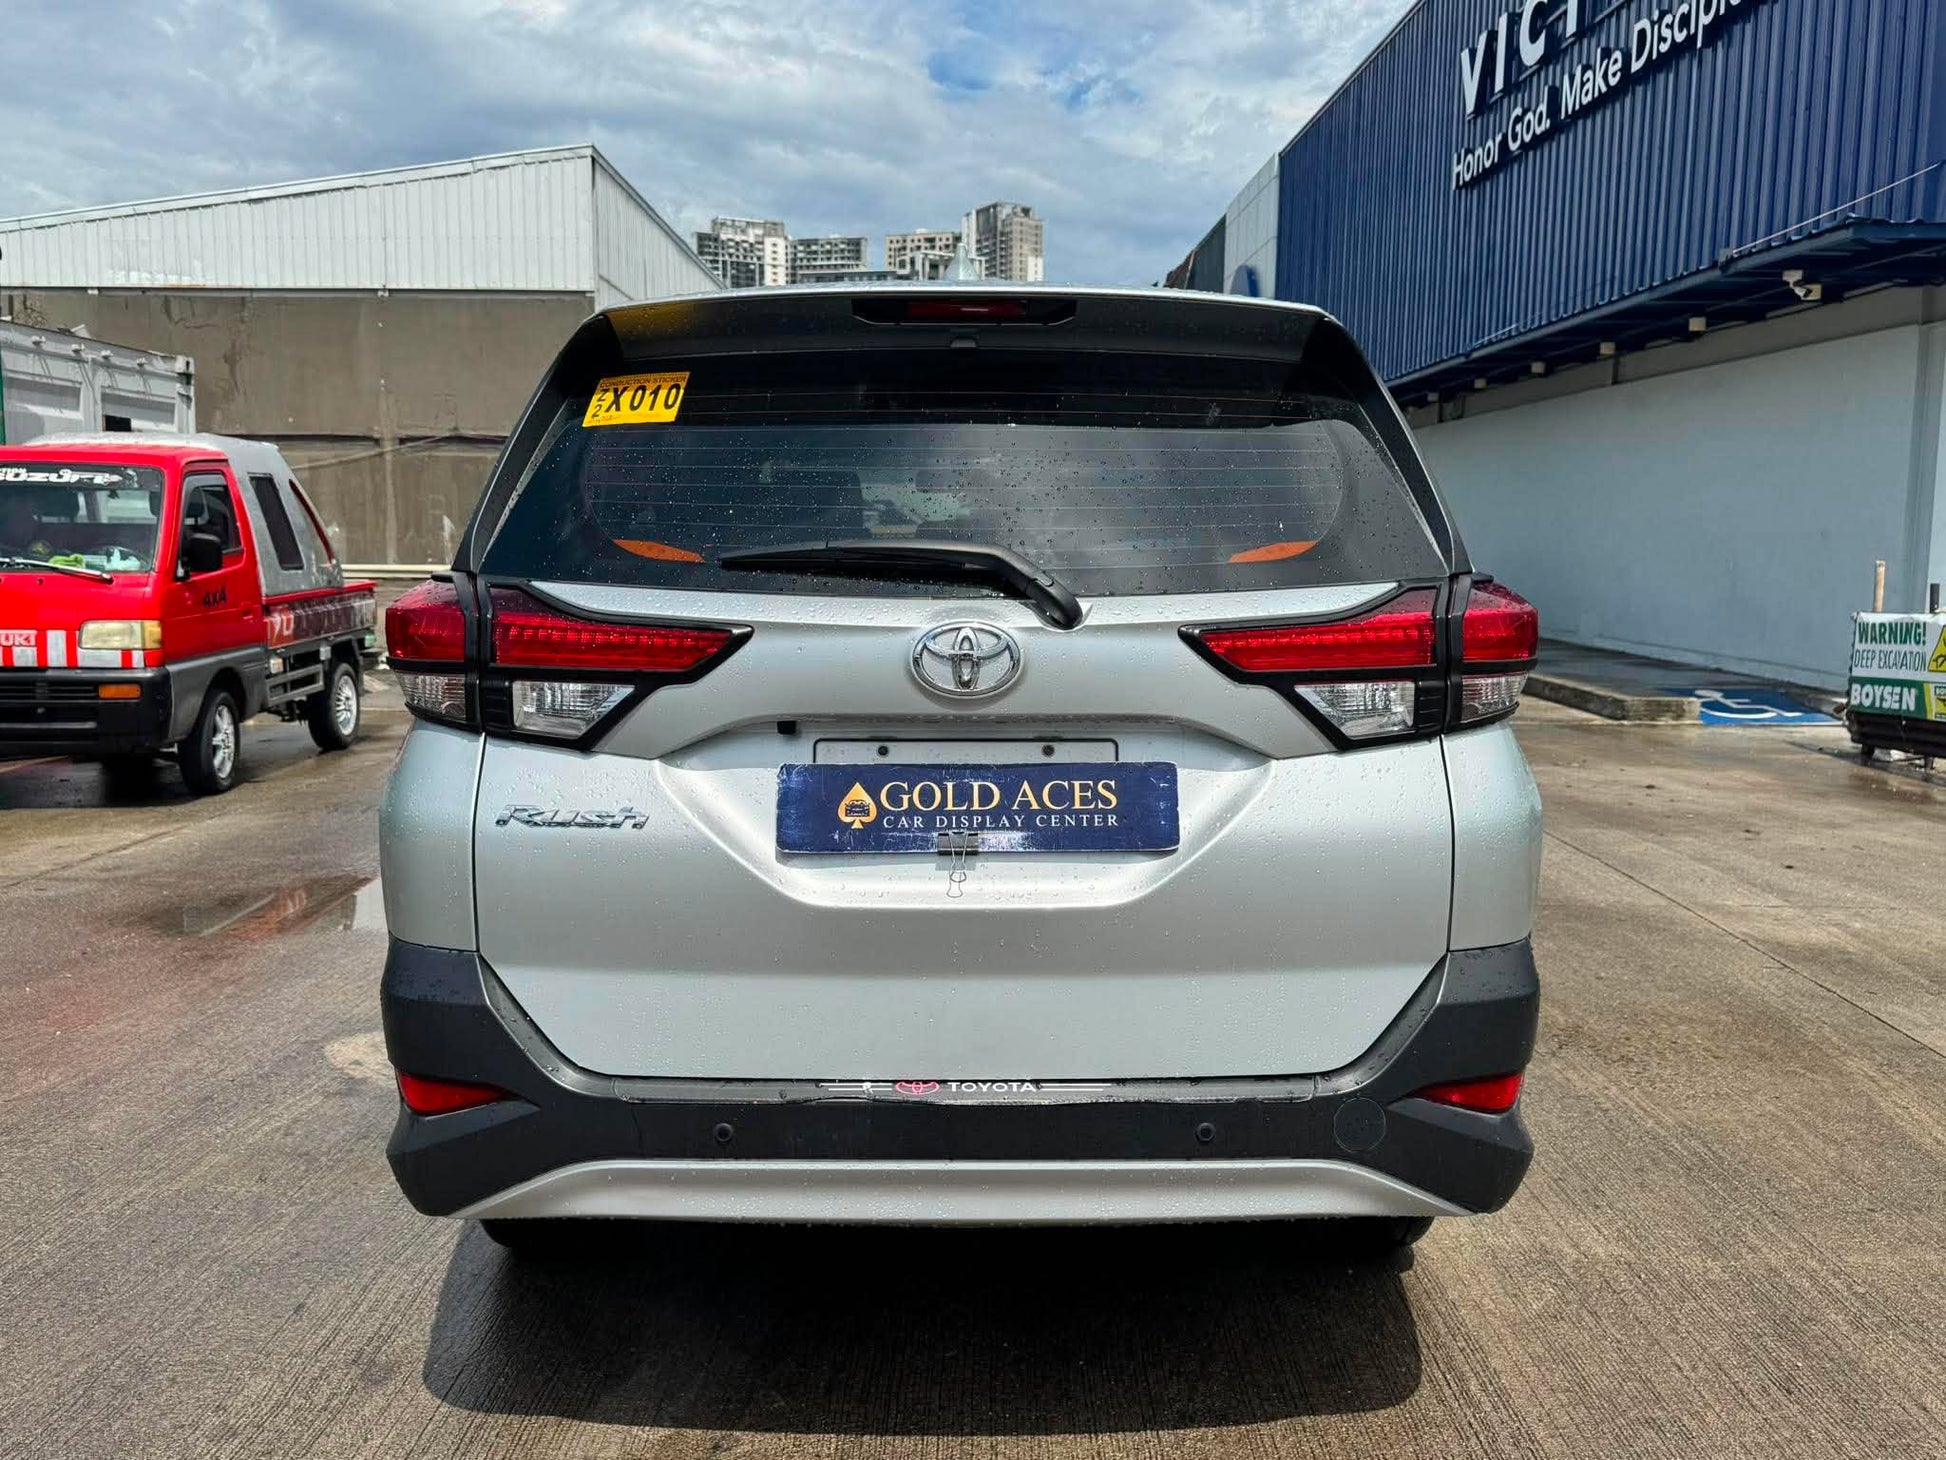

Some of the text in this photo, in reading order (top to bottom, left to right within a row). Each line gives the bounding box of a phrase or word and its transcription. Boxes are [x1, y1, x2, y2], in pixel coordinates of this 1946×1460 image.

[1452, 132, 1502, 190] Honor
[1560, 46, 1623, 120] Make
[1630, 0, 1741, 74] Discip
[1858, 621, 1927, 646] WARNING!
[1854, 648, 1876, 669] DEEP
[1851, 683, 1916, 711] BOYSEN
[880, 780, 1118, 812] GOLD ACES
[496, 804, 649, 829] Rush
[883, 814, 1119, 829] CAR DISPLAY CENTER
[948, 1082, 1036, 1092] TOYOTA
